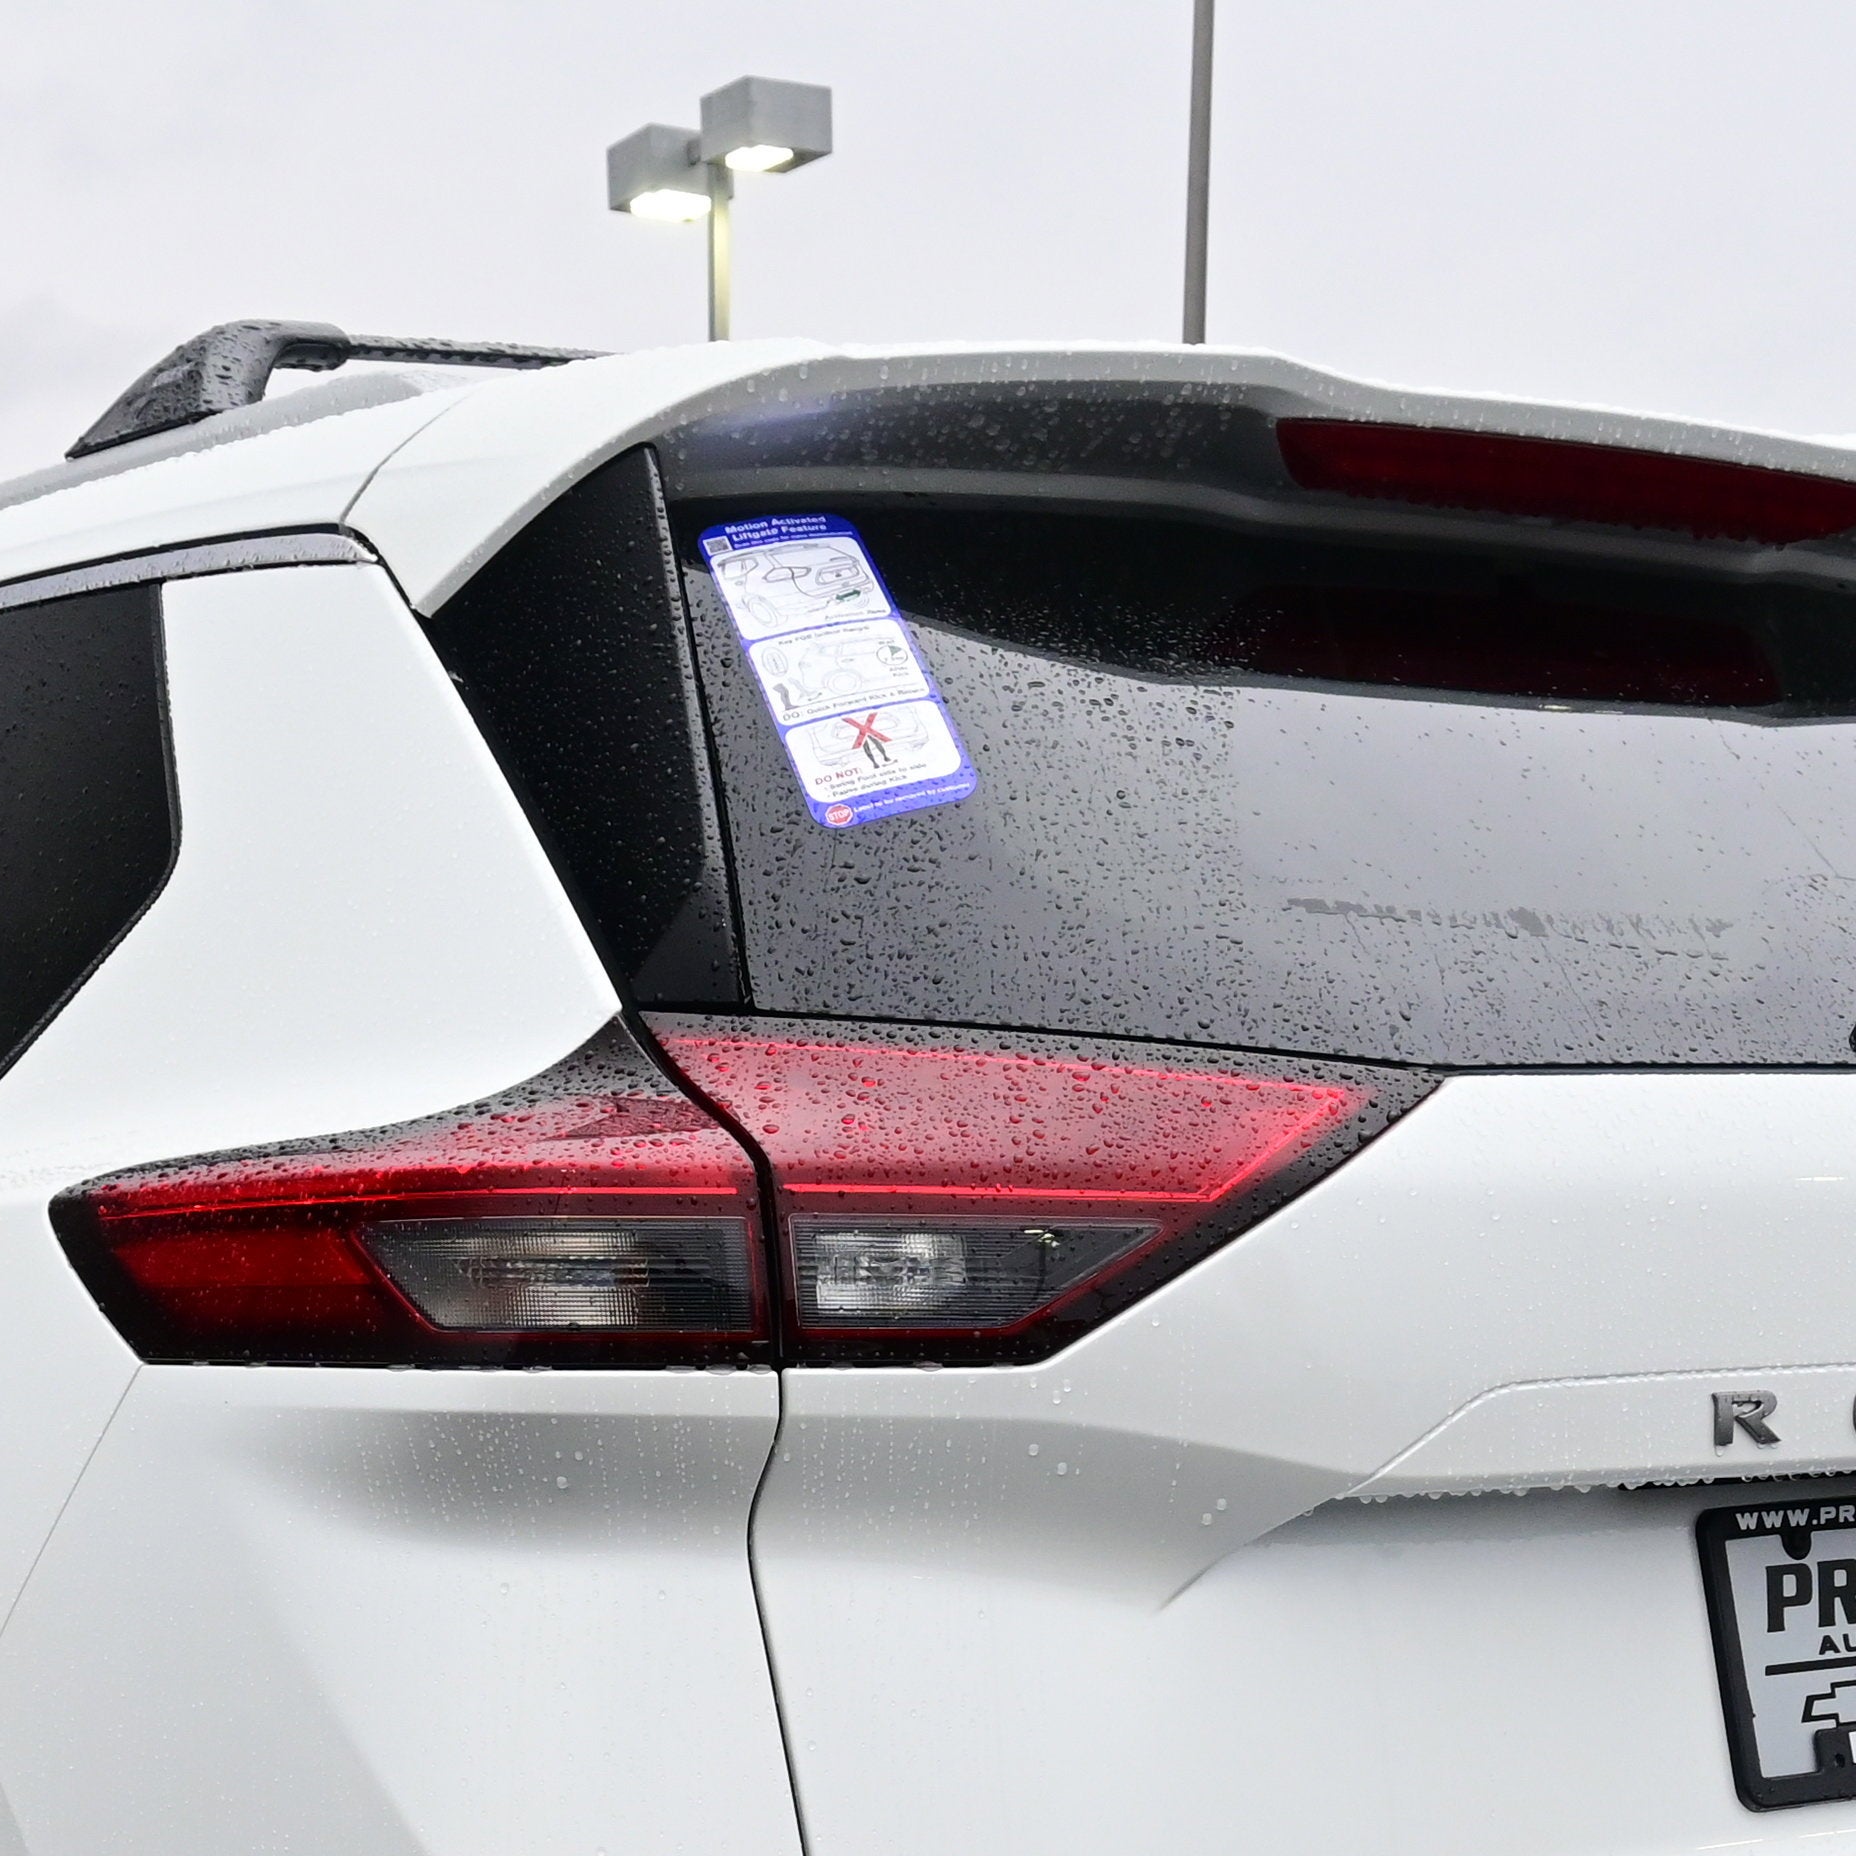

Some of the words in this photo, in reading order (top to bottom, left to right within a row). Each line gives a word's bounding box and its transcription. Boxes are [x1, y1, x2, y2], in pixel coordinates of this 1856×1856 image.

[724, 520, 768, 534] Motion
[771, 516, 826, 526] Activated
[732, 528, 778, 542] Liftgate
[781, 524, 827, 534] Feature
[815, 775, 832, 785] DO
[828, 809, 850, 822] STOP
